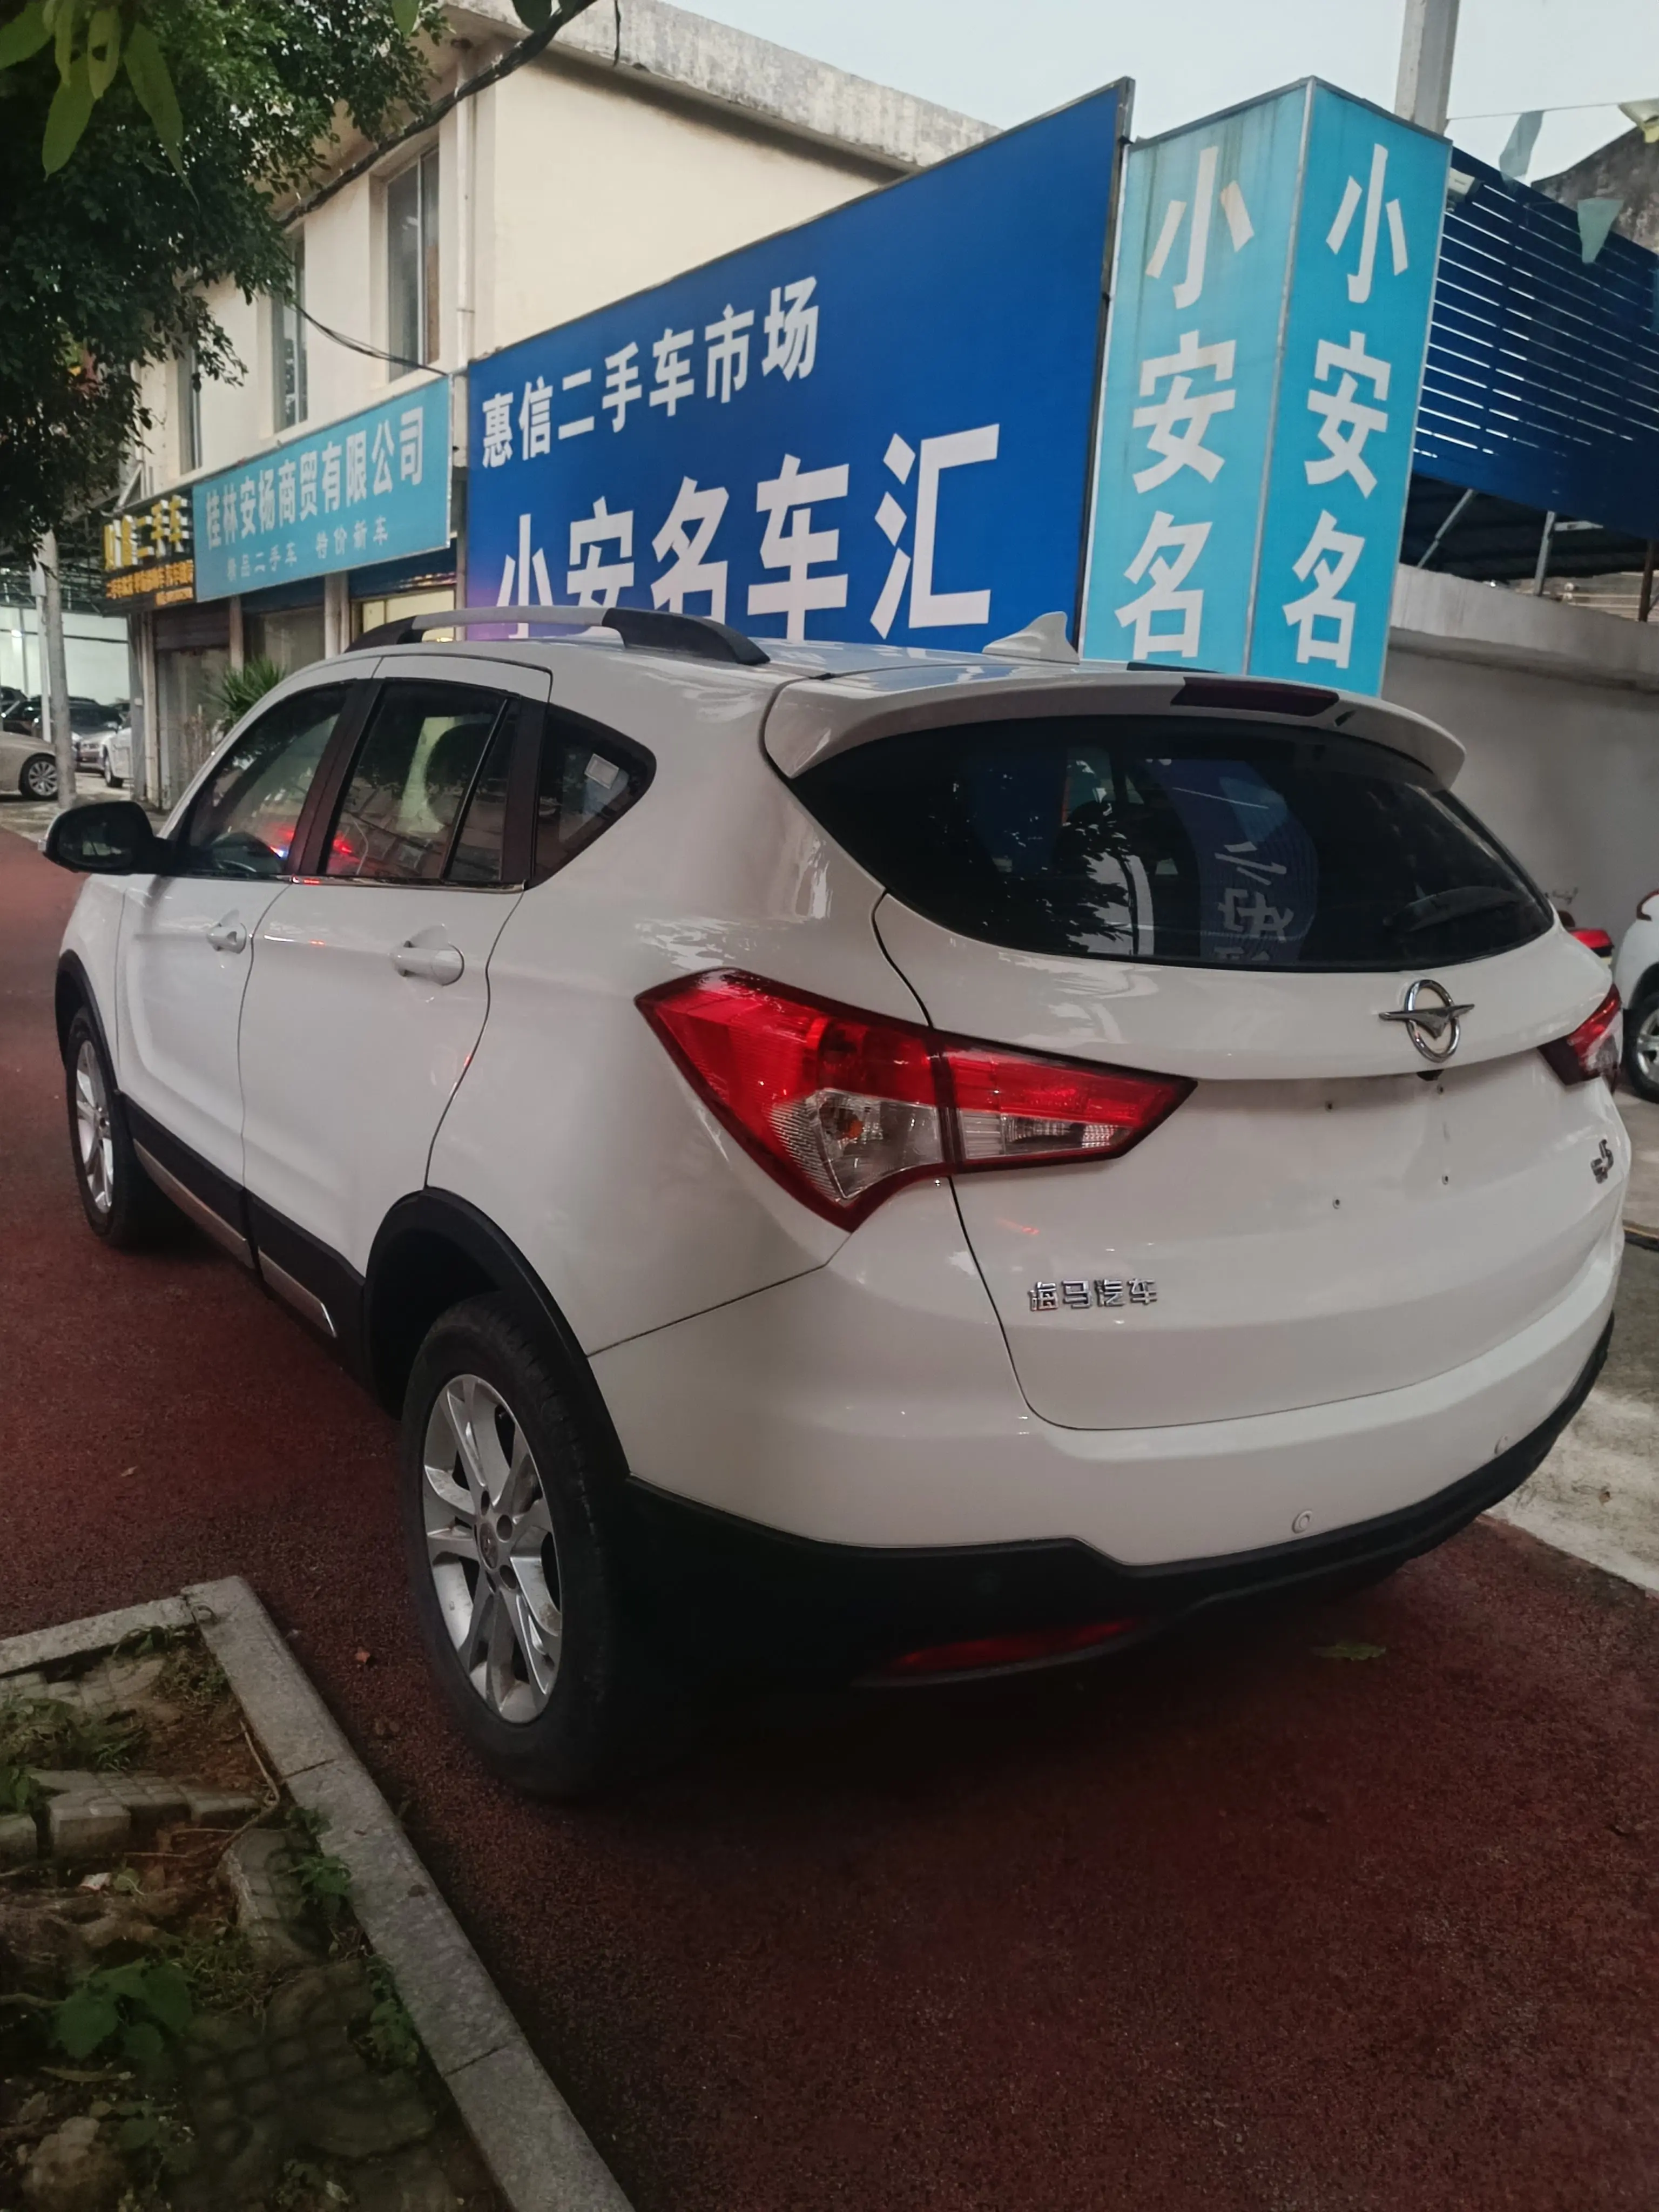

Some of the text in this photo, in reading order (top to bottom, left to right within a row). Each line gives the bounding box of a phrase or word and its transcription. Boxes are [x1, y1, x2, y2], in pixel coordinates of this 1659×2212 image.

[482, 276, 819, 468] 惠信二手车市场
[1115, 144, 1253, 661] 小安名
[1282, 143, 1408, 669] 小安名
[495, 423, 1000, 641] 小安名车汇
[1028, 1278, 1157, 1311] 海马汽车
